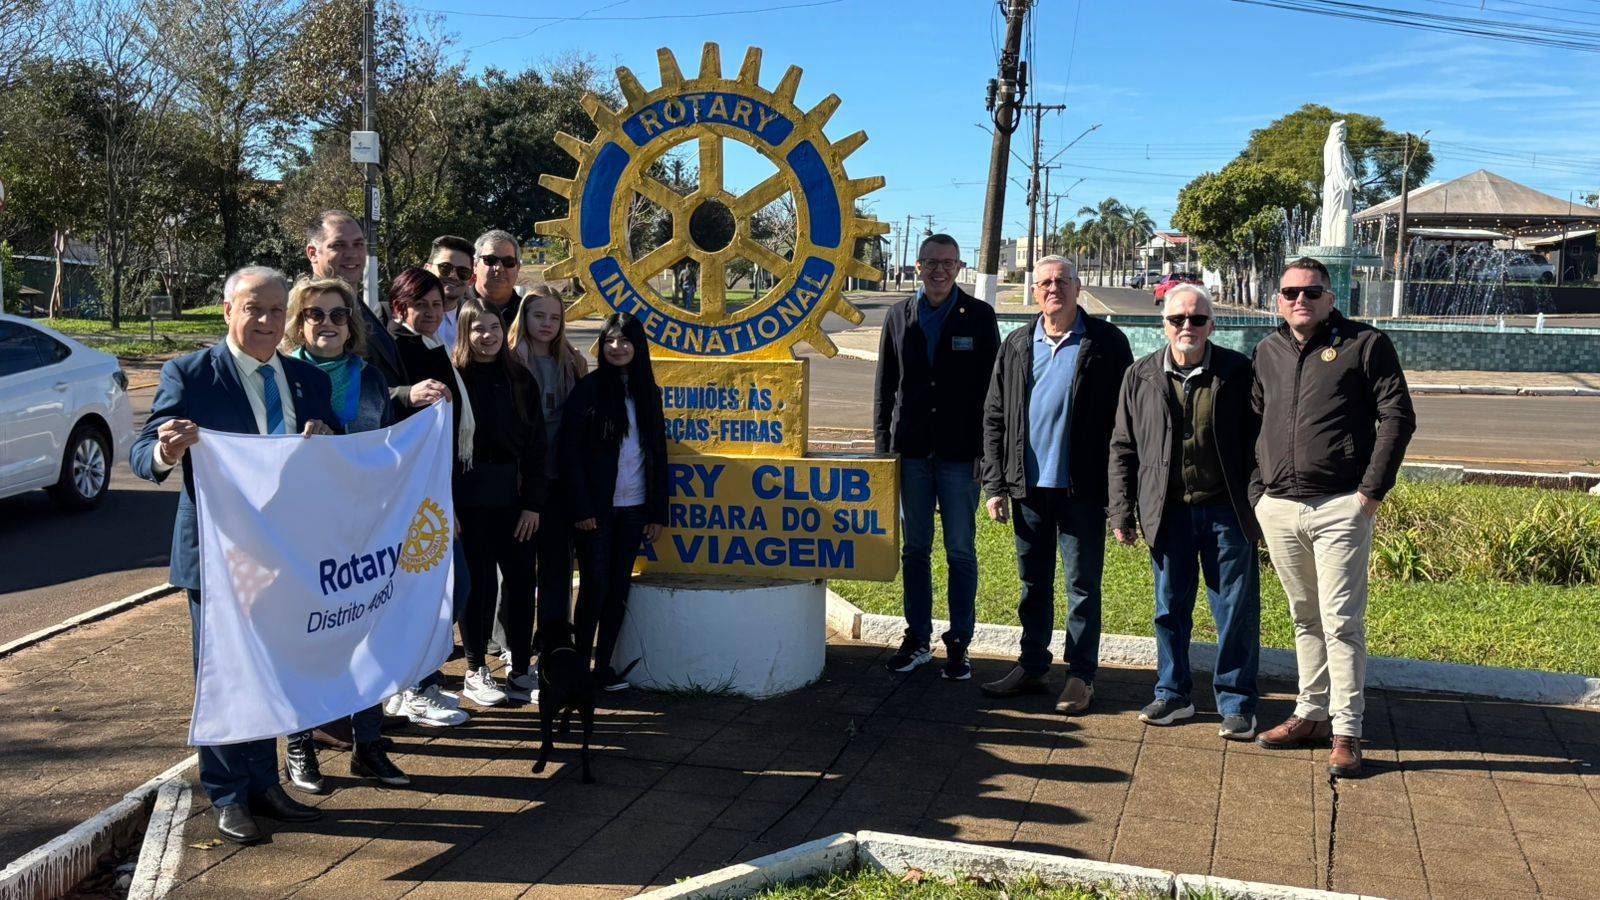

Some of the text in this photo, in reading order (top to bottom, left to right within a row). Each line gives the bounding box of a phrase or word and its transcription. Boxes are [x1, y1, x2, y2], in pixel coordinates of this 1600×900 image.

[640, 94, 779, 137] ROTARY
[599, 271, 832, 356] INTERNATIONAL
[659, 380, 773, 412] EUNIÕES ÀS
[665, 417, 784, 445] RÇAS-FEIRAS
[667, 463, 872, 503] RY CLUB
[670, 503, 887, 536] RBARA DO SUL
[319, 542, 403, 596] Rotary
[671, 534, 856, 569] VIAGEM
[307, 600, 365, 634] Distrito
